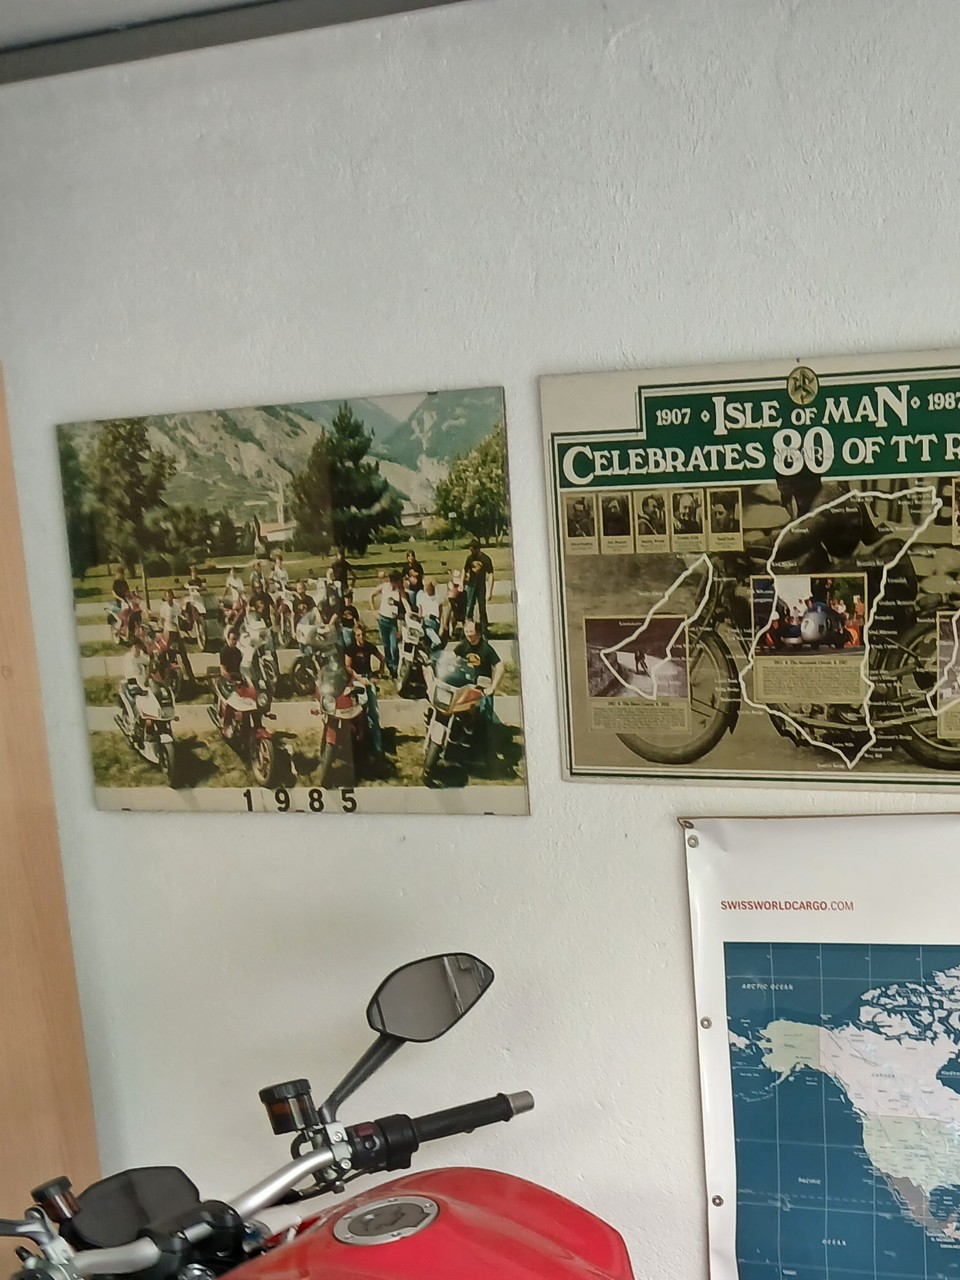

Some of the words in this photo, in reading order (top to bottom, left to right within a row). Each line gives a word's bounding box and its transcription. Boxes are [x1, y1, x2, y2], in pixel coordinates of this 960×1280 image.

[656, 408, 691, 426] 1907
[712, 396, 782, 436] ISLE
[790, 407, 817, 426] OF
[822, 385, 911, 428] MAN
[562, 441, 766, 485] CELEBRATES
[772, 426, 834, 476] 80
[842, 435, 886, 465] OF
[891, 433, 938, 463] TT
[242, 788, 359, 813] 1985
[720, 900, 855, 911] SWISSWORLDCARGO.COM
[769, 983, 794, 991] OCEAN
